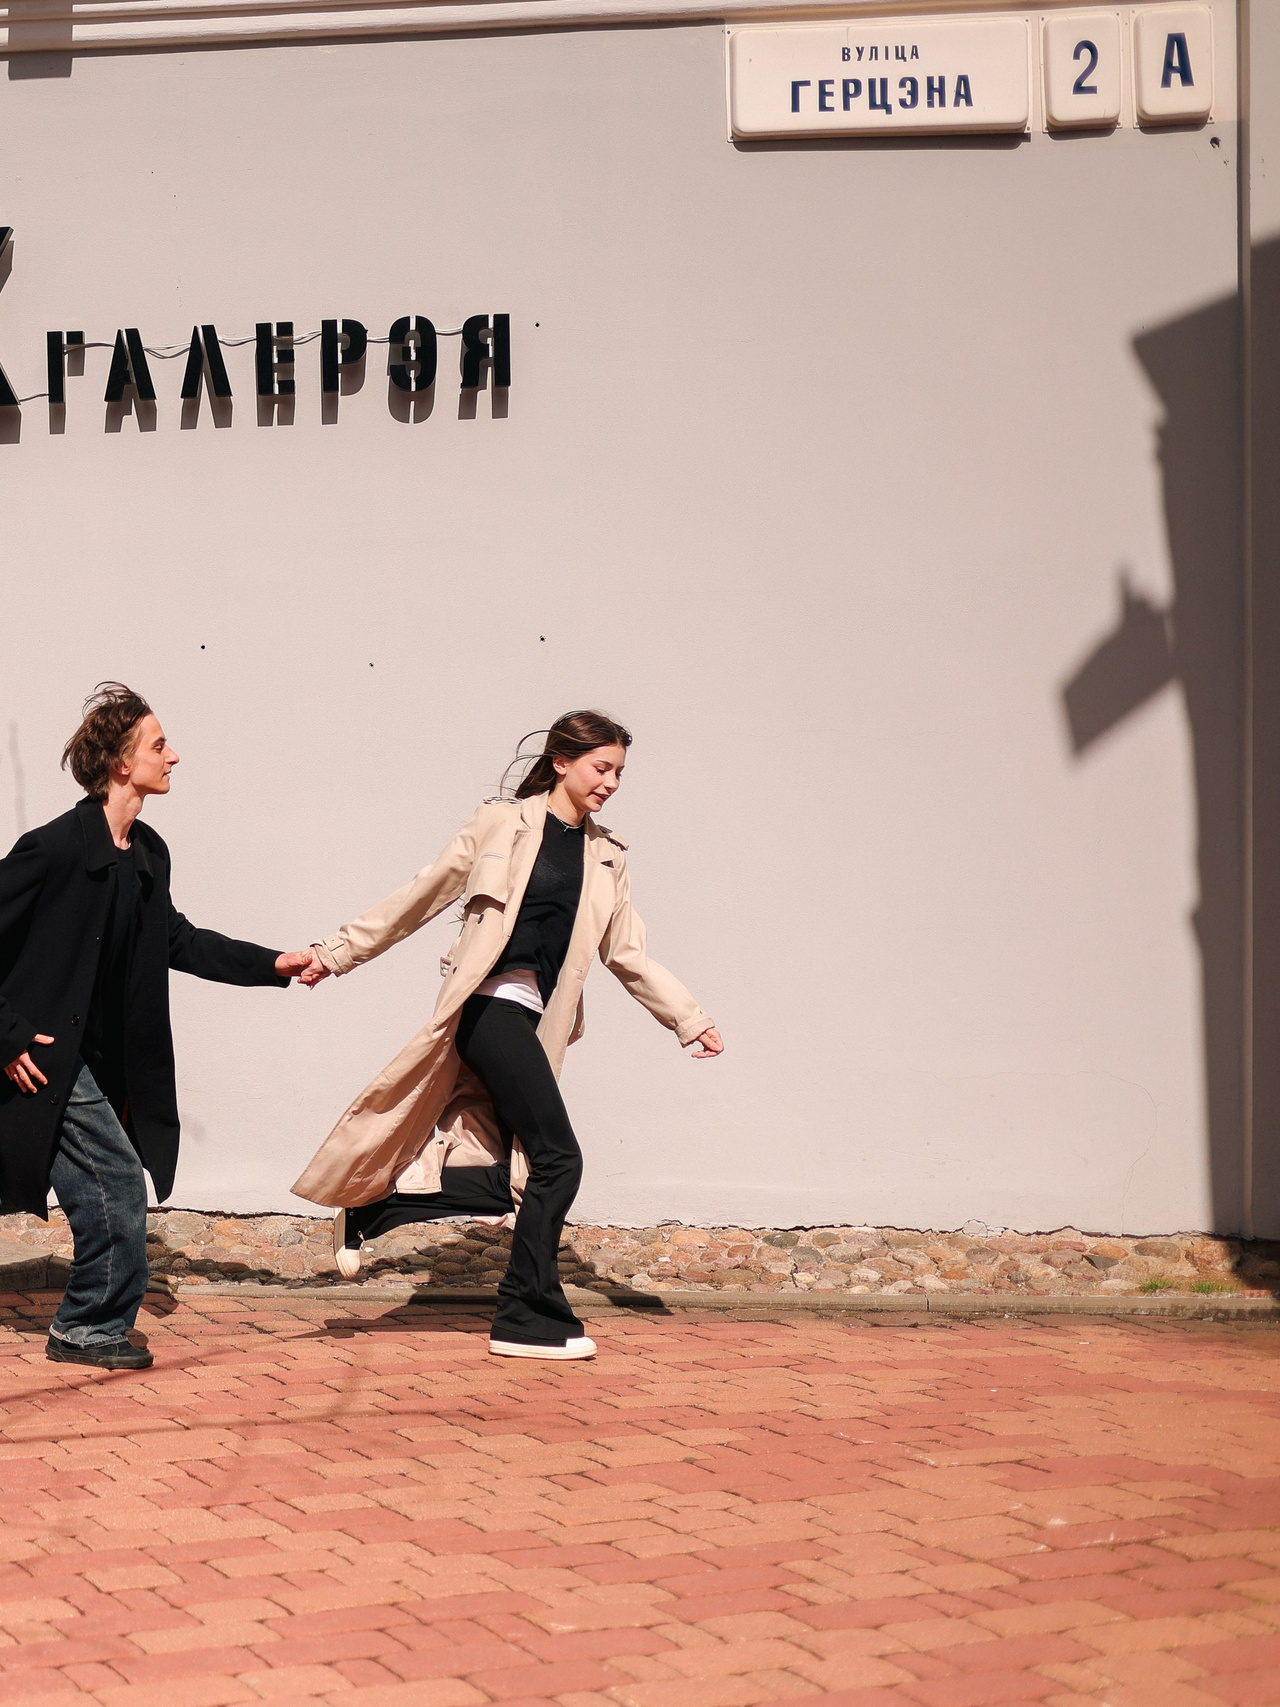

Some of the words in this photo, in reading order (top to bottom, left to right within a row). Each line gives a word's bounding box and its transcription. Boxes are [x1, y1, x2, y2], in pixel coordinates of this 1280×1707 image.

[841, 44, 920, 63] ВУЛІЦА
[1072, 40, 1098, 96] 2
[790, 74, 974, 115] ГЕРЦЭНА
[47, 313, 511, 404] ГАЛЕРЭЯ
